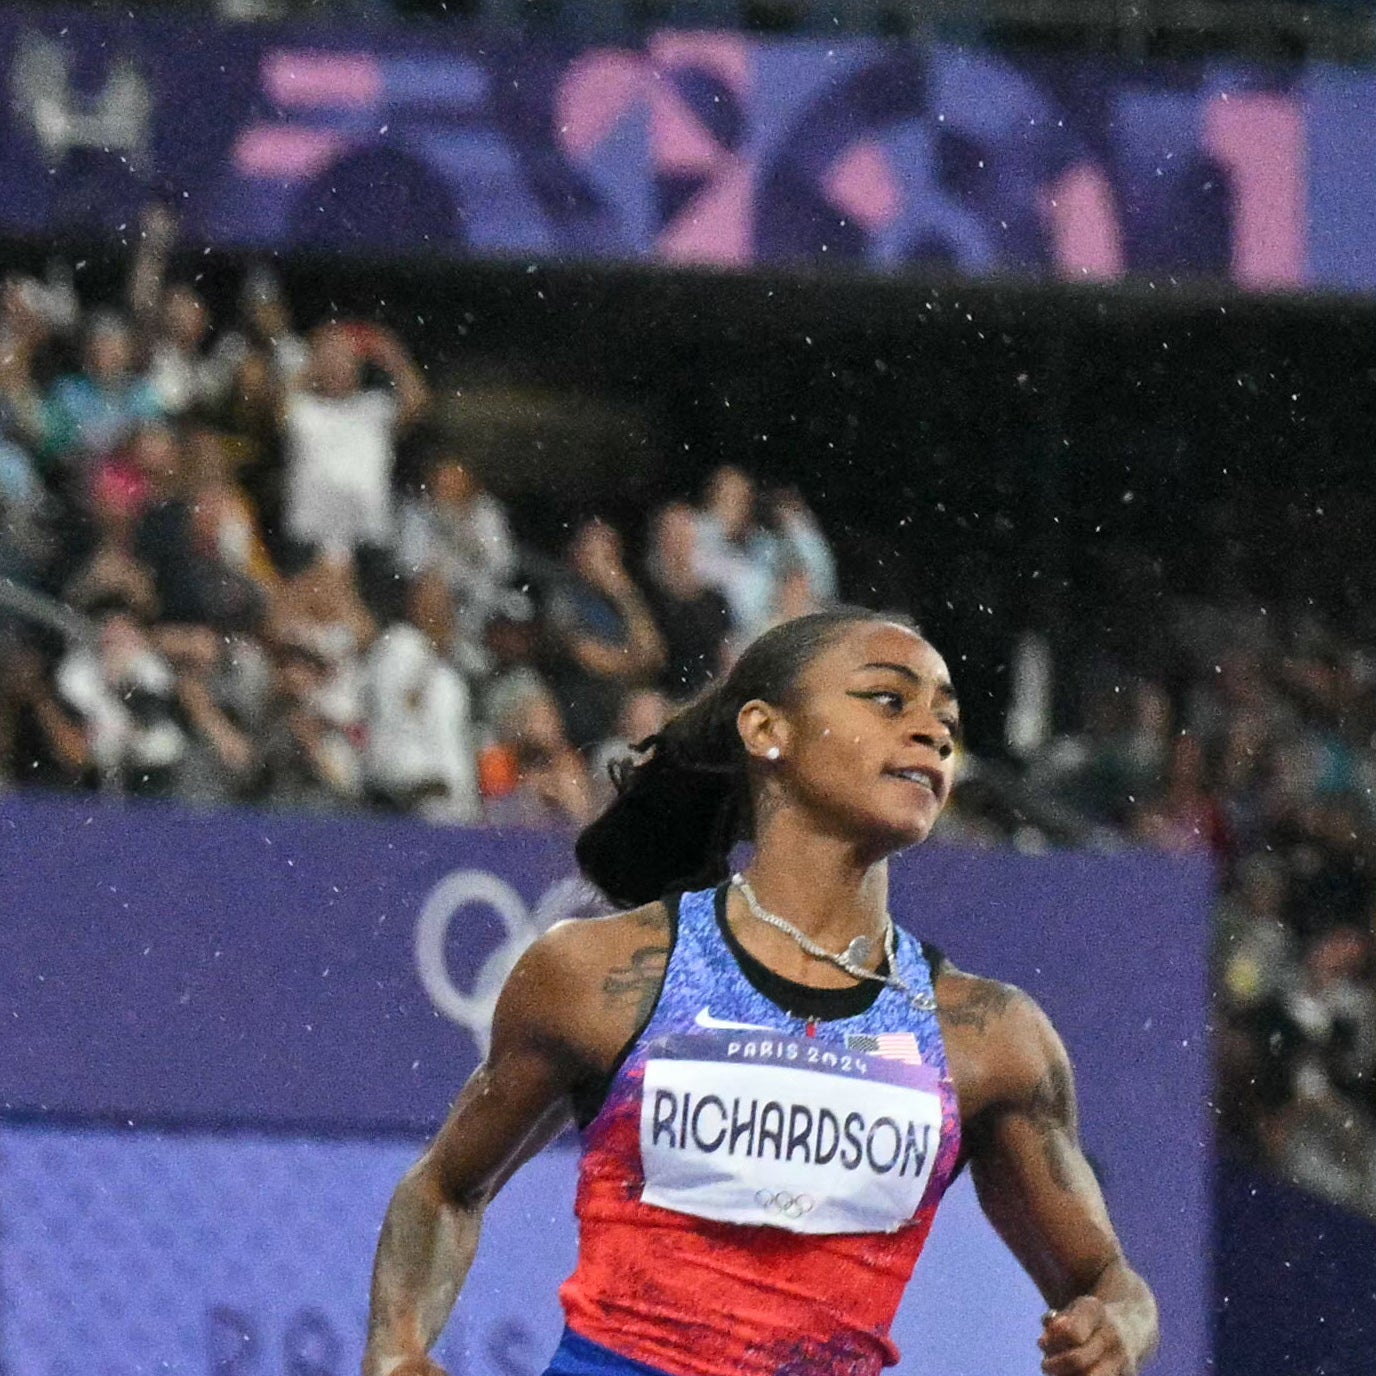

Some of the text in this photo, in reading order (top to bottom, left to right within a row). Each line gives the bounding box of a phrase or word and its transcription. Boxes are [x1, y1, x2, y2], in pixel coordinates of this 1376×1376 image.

[726, 1040, 868, 1075] PARIS 2024
[652, 1087, 931, 1178] RICHARDSON
